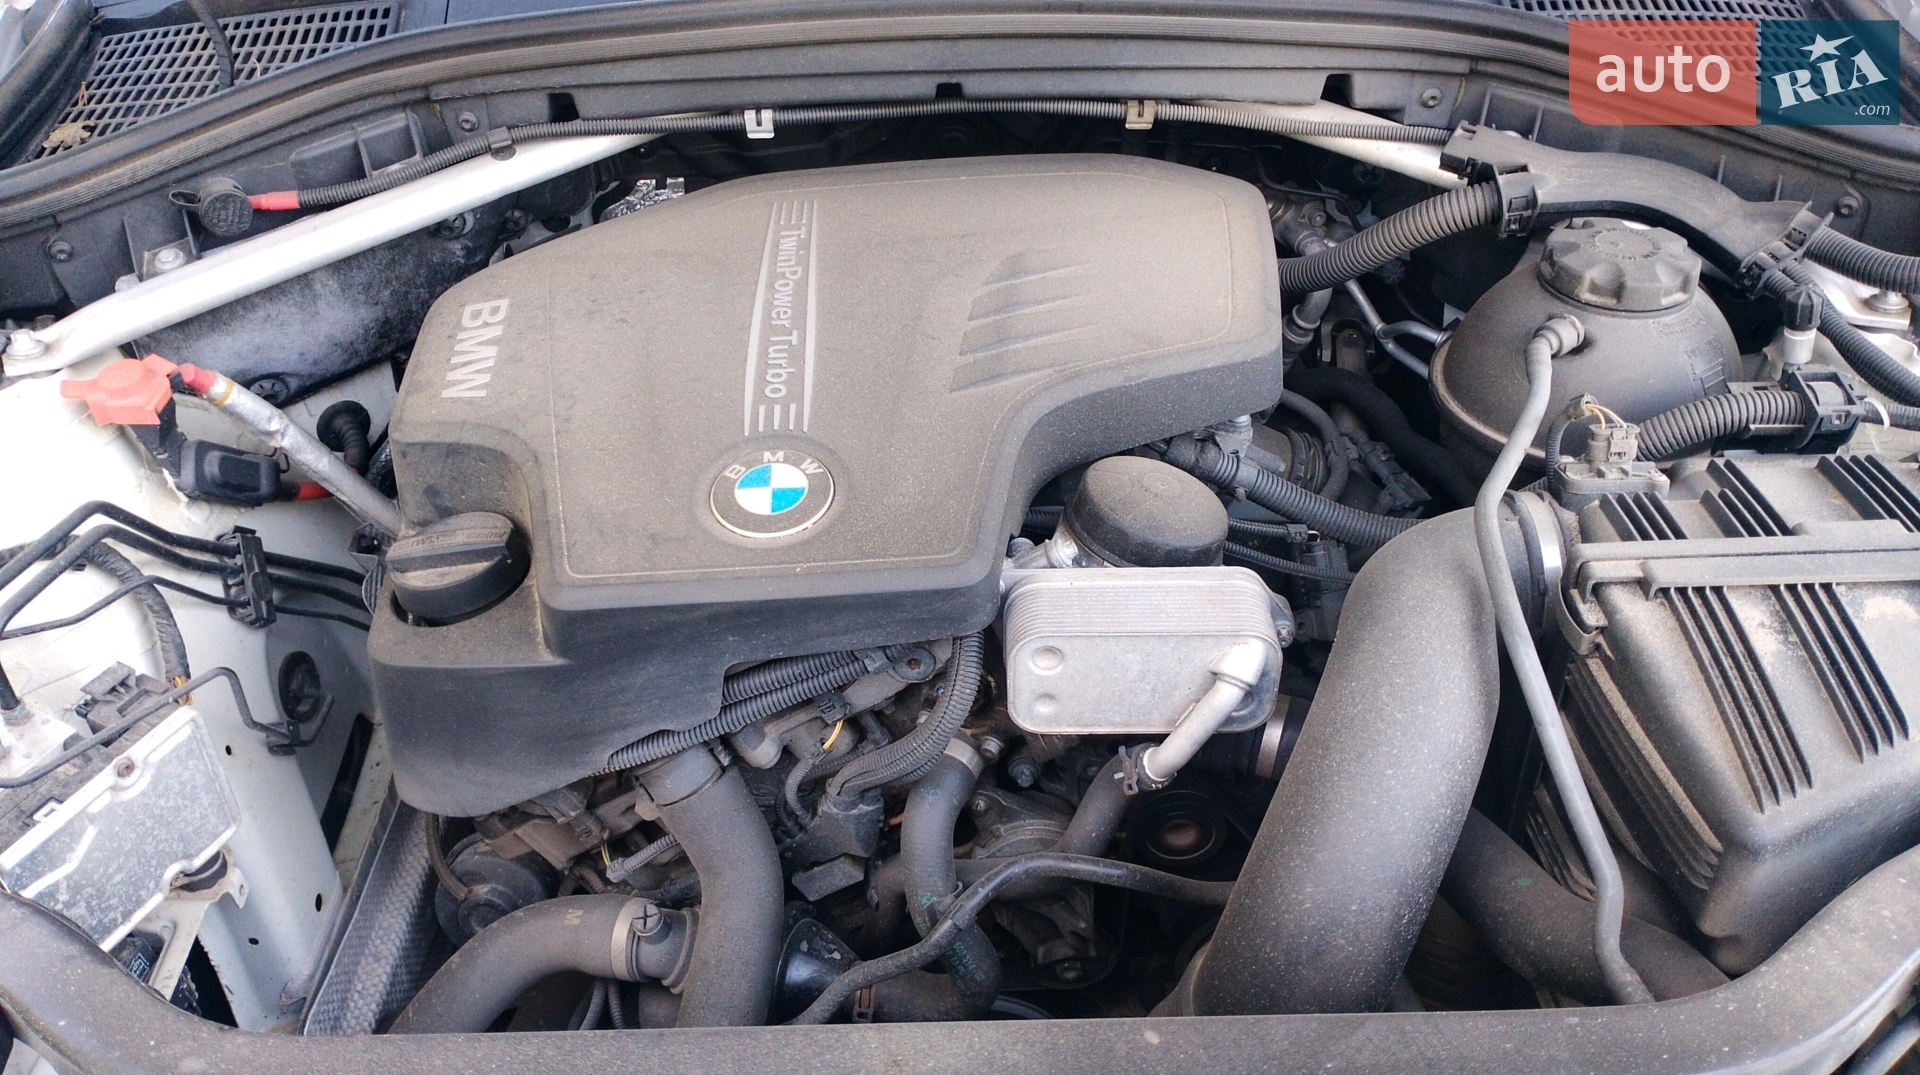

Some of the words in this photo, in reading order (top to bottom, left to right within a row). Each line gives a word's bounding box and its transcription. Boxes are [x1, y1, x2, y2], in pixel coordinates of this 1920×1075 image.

[771, 226, 806, 328] TwinPower
[440, 298, 509, 398] BMW
[764, 330, 798, 398] Turbo
[723, 451, 824, 480] BMW
